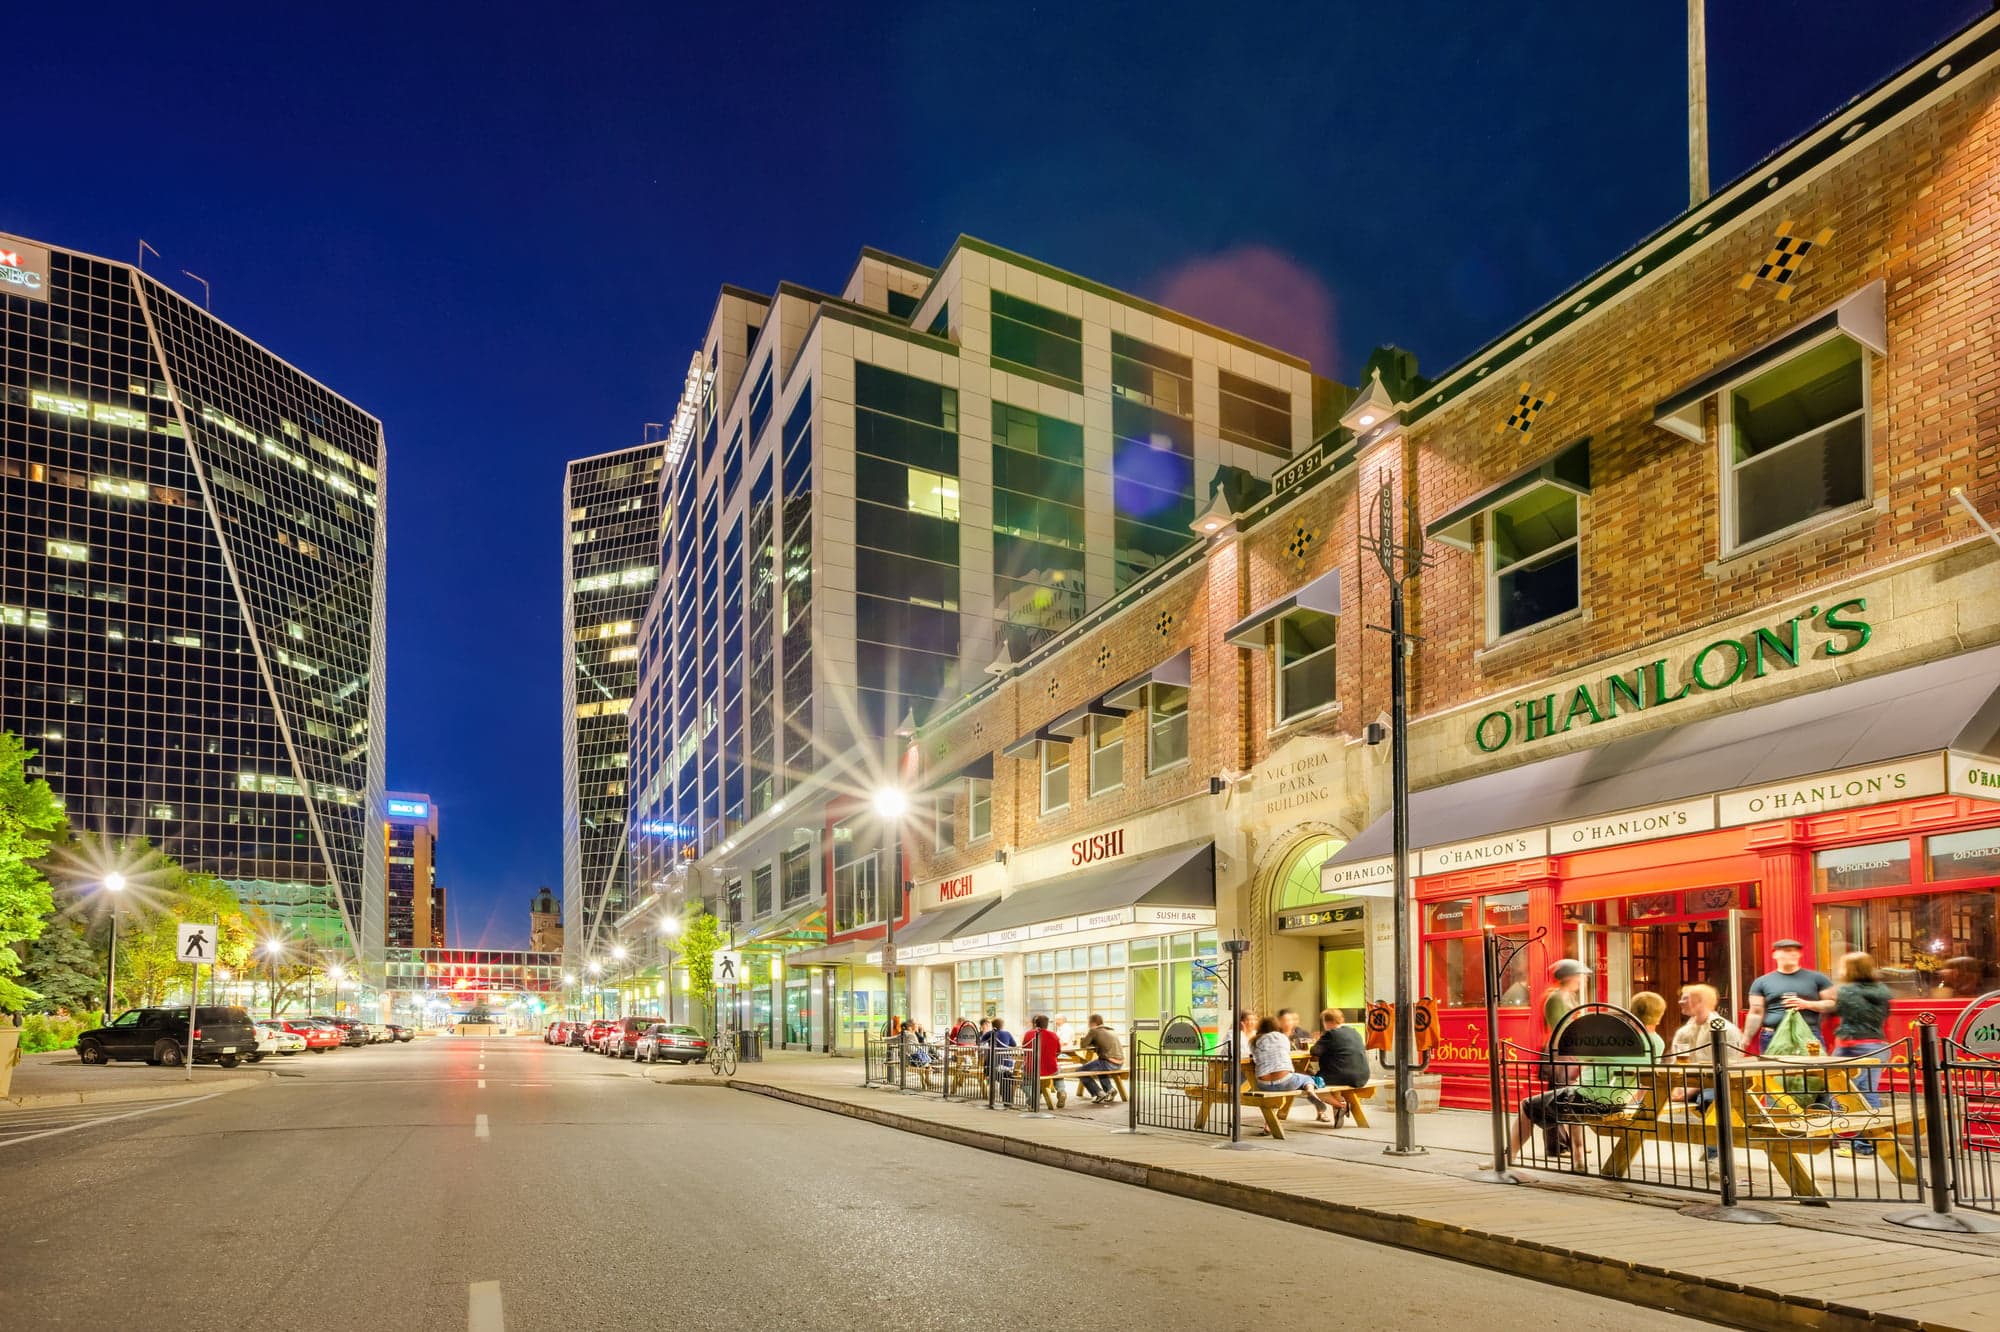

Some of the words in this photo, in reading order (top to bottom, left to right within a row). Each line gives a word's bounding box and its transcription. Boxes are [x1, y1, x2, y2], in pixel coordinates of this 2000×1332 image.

[1282, 458, 1313, 489] 1929
[1382, 488, 1392, 568] DOWNTOWN
[1475, 597, 1873, 753] O'HANLON'S
[1266, 752, 1329, 780] VICTORIA
[1279, 775, 1315, 794] PARK
[1748, 772, 1907, 813] O'HANLON'S
[1267, 786, 1329, 815] BUILDING
[1572, 811, 1688, 843] O'HANLON'S
[1071, 828, 1125, 866] SUSHI
[1439, 838, 1527, 865] O'HANLON'S
[1334, 863, 1394, 883] O'HANLON
[940, 875, 974, 902] MICHI
[1155, 911, 1180, 920] SUSHI
[1181, 912, 1197, 920] BAR
[1300, 909, 1344, 924] 1945
